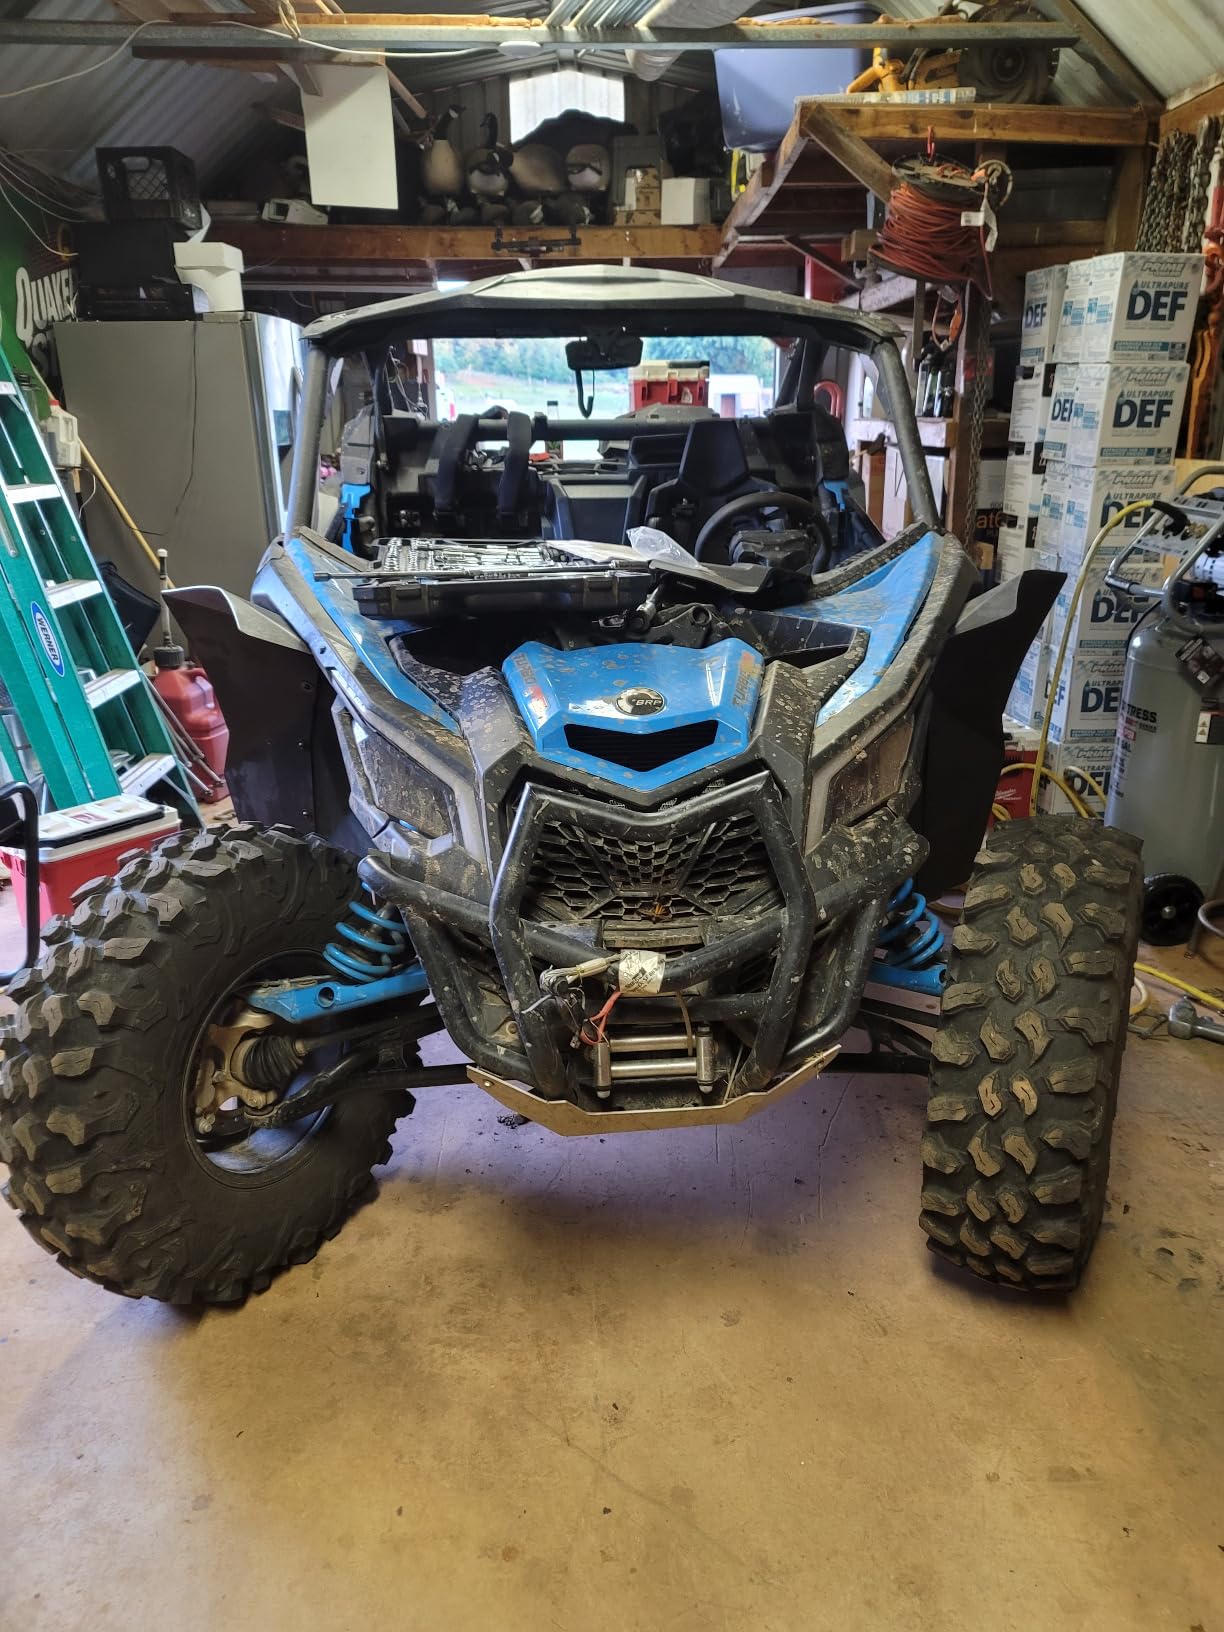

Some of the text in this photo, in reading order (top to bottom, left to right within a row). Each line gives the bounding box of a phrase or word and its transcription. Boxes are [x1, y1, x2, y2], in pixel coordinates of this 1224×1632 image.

[1140, 281, 1190, 289] ULTRAPURE
[16, 266, 74, 349] QUAKE
[1025, 303, 1047, 329] DEF
[1126, 290, 1188, 321] DEF
[1126, 390, 1175, 398] ULTRAPURE
[1112, 400, 1173, 428] DEF
[1091, 597, 1149, 623] DEF
[37, 617, 59, 661] WERNER
[1081, 687, 1122, 713] DE
